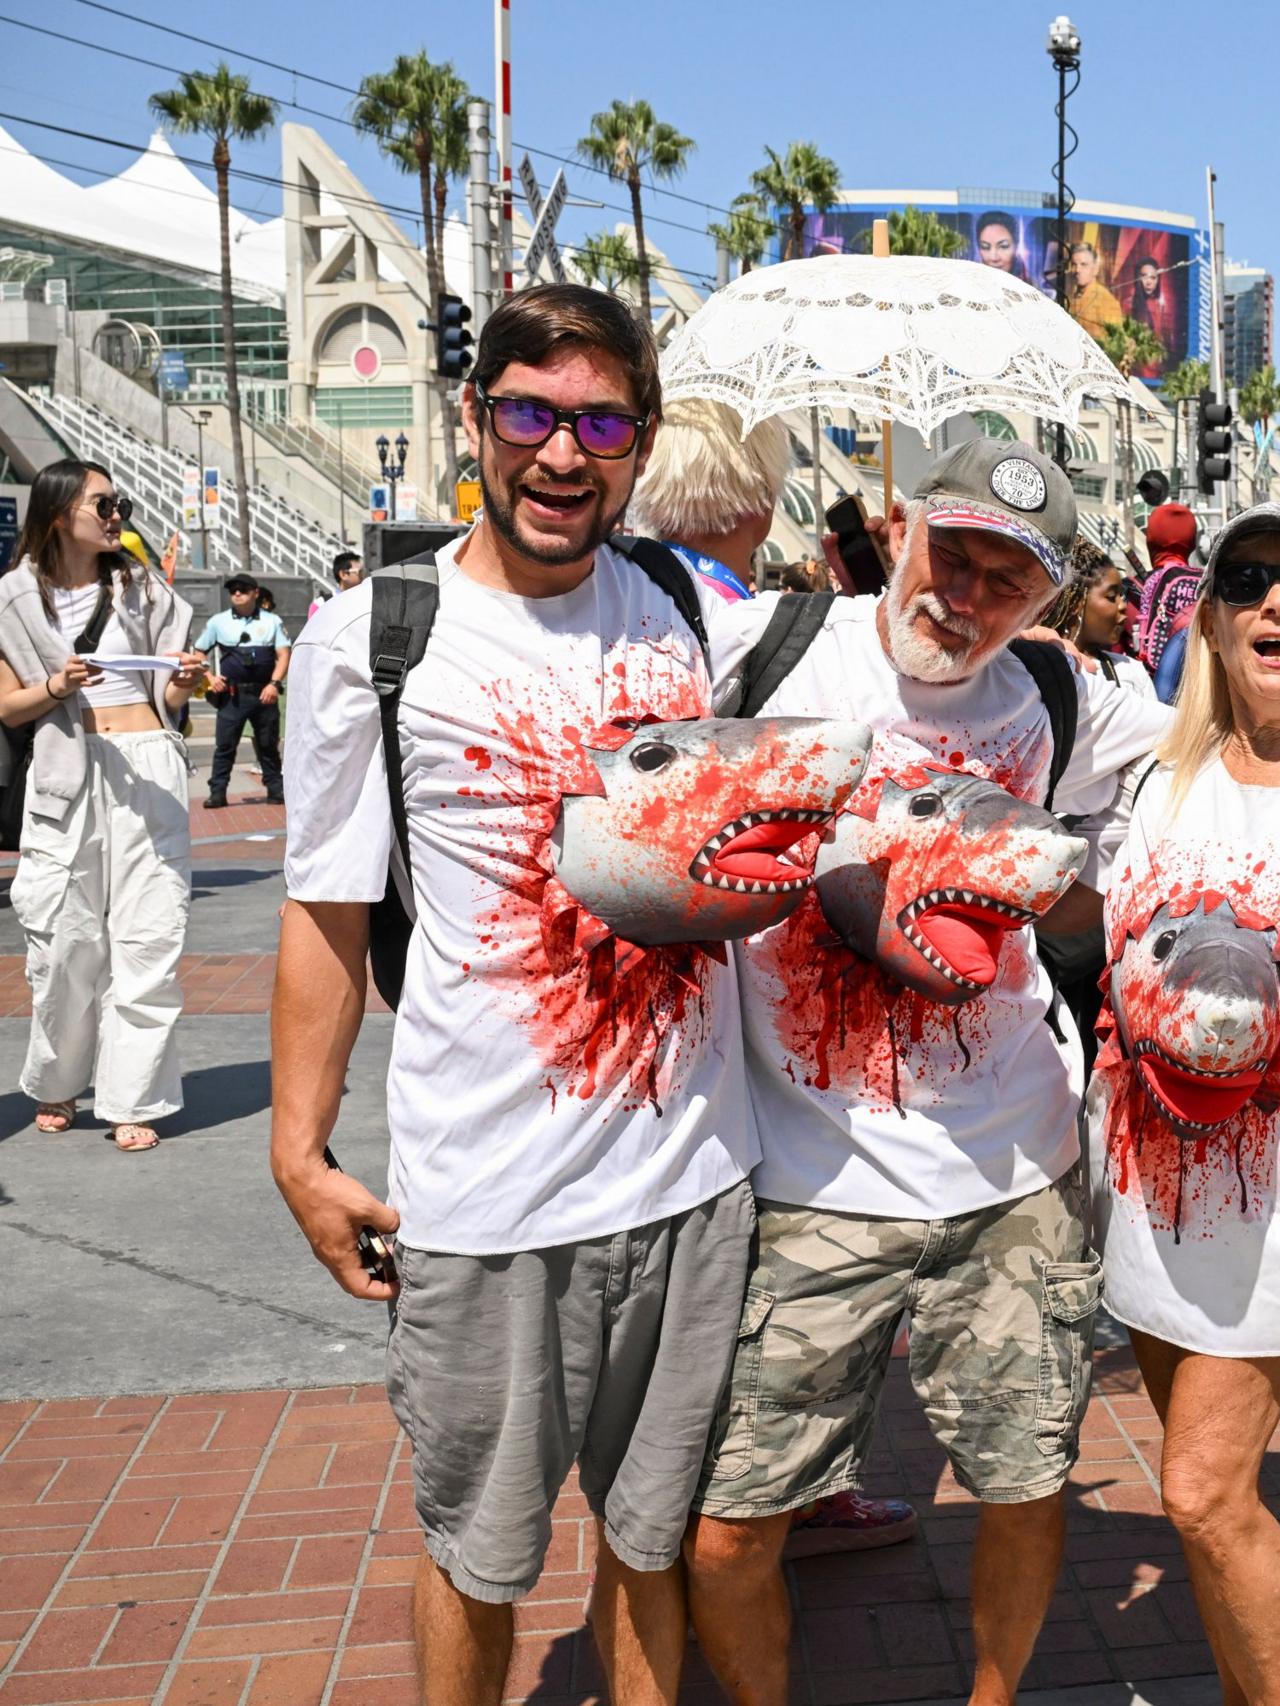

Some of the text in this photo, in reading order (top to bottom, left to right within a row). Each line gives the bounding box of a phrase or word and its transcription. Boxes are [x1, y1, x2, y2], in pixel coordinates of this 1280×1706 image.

[1006, 460, 1039, 476] VINTAGE
[1008, 470, 1035, 487] 1953
[1011, 488, 1023, 498] 70
